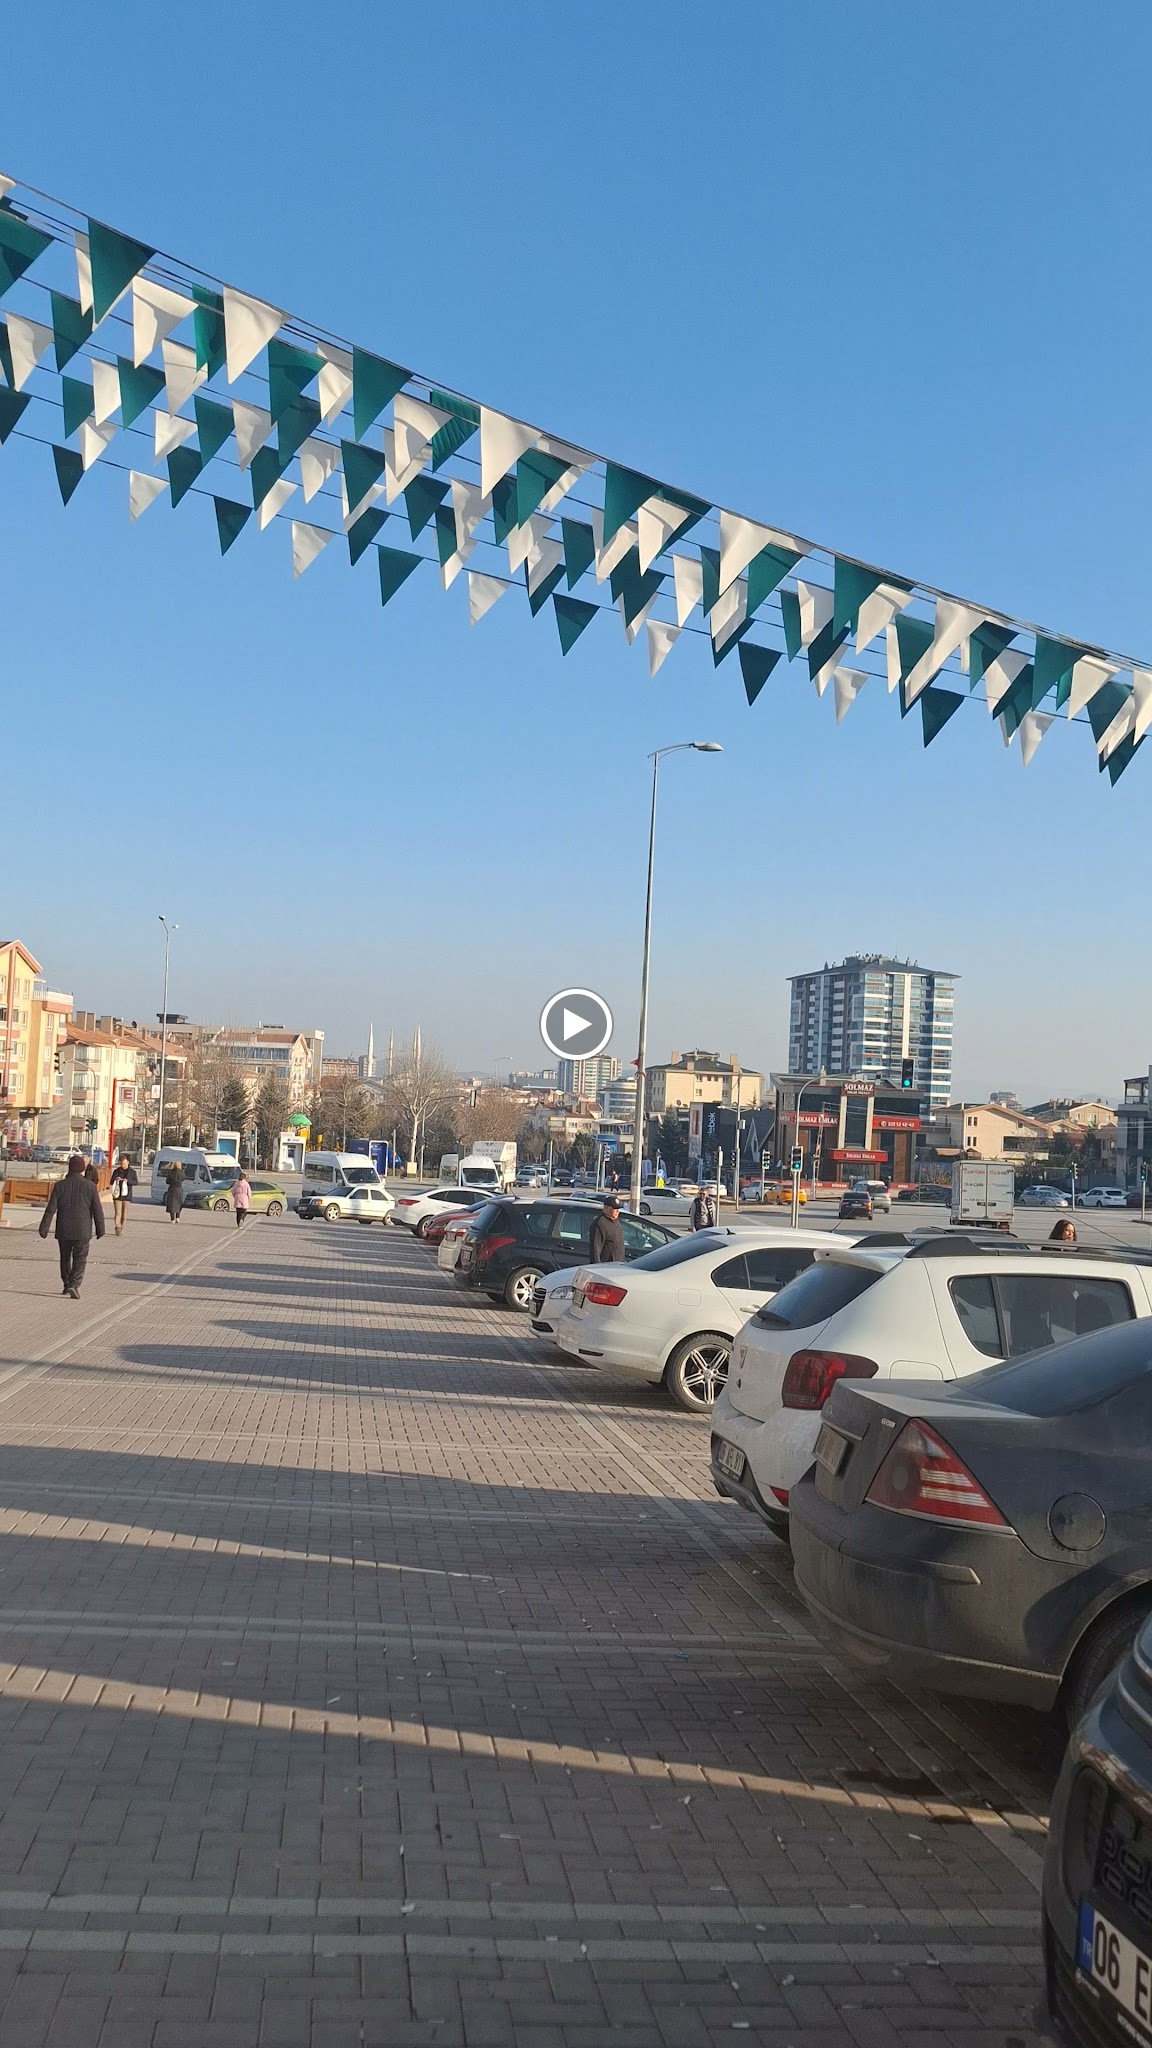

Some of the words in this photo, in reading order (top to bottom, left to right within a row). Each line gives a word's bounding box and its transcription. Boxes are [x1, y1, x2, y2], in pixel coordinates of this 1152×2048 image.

[844, 1083, 874, 1091] SOLMAZ
[1083, 1937, 1092, 1958] TR
[1094, 1920, 1120, 1990] 06
[1134, 1953, 1152, 2026] E
